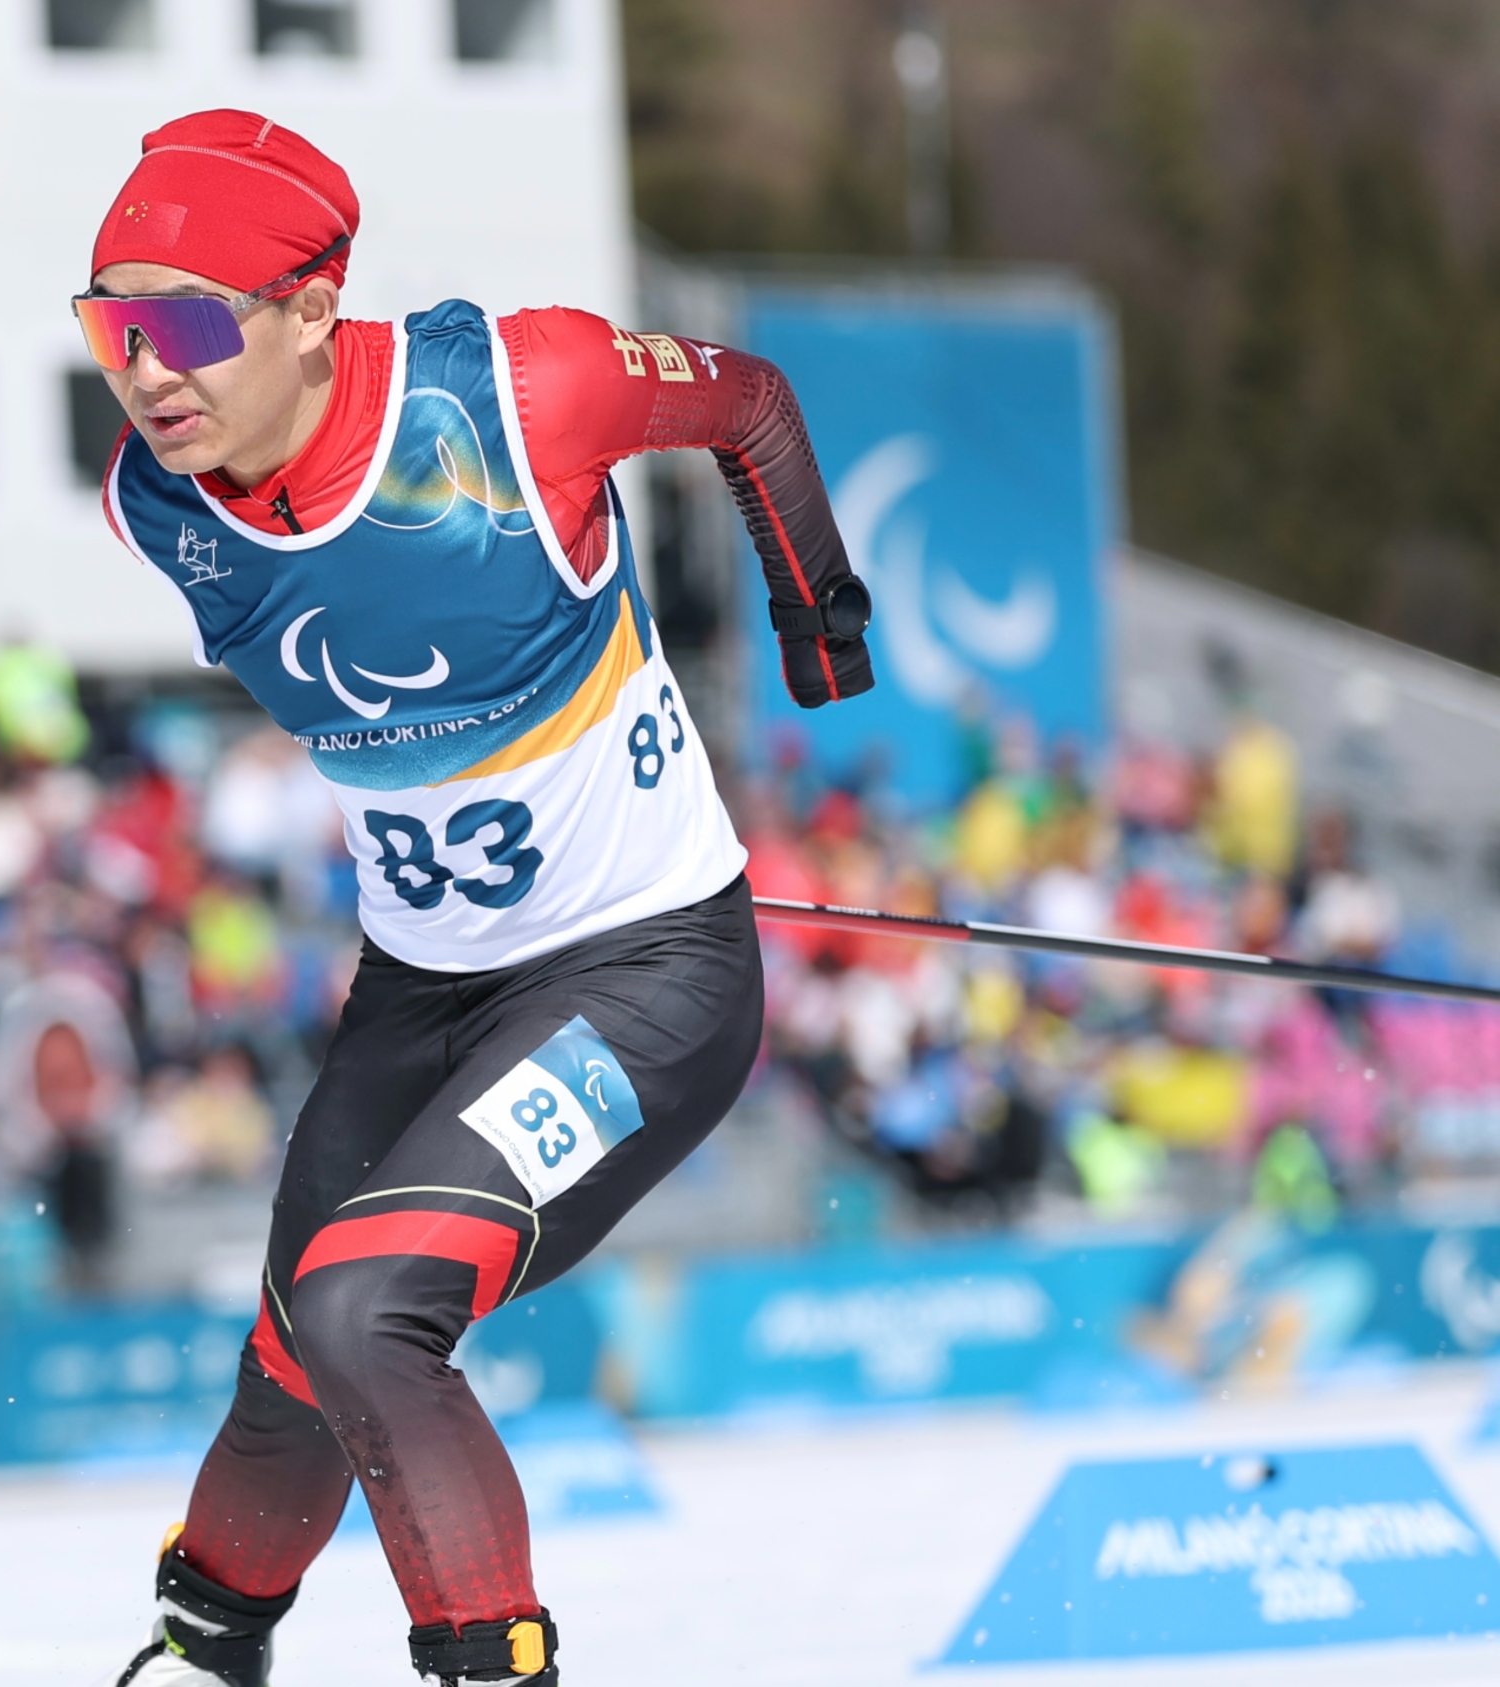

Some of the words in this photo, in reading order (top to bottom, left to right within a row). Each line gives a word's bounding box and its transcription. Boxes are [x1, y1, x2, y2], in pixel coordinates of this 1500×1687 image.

[607, 322, 695, 382] 中国
[628, 683, 685, 790] 83
[364, 798, 544, 910] 83
[476, 1116, 510, 1143] MILANO
[509, 1142, 531, 1181] CORTINA
[511, 1088, 577, 1168] 83
